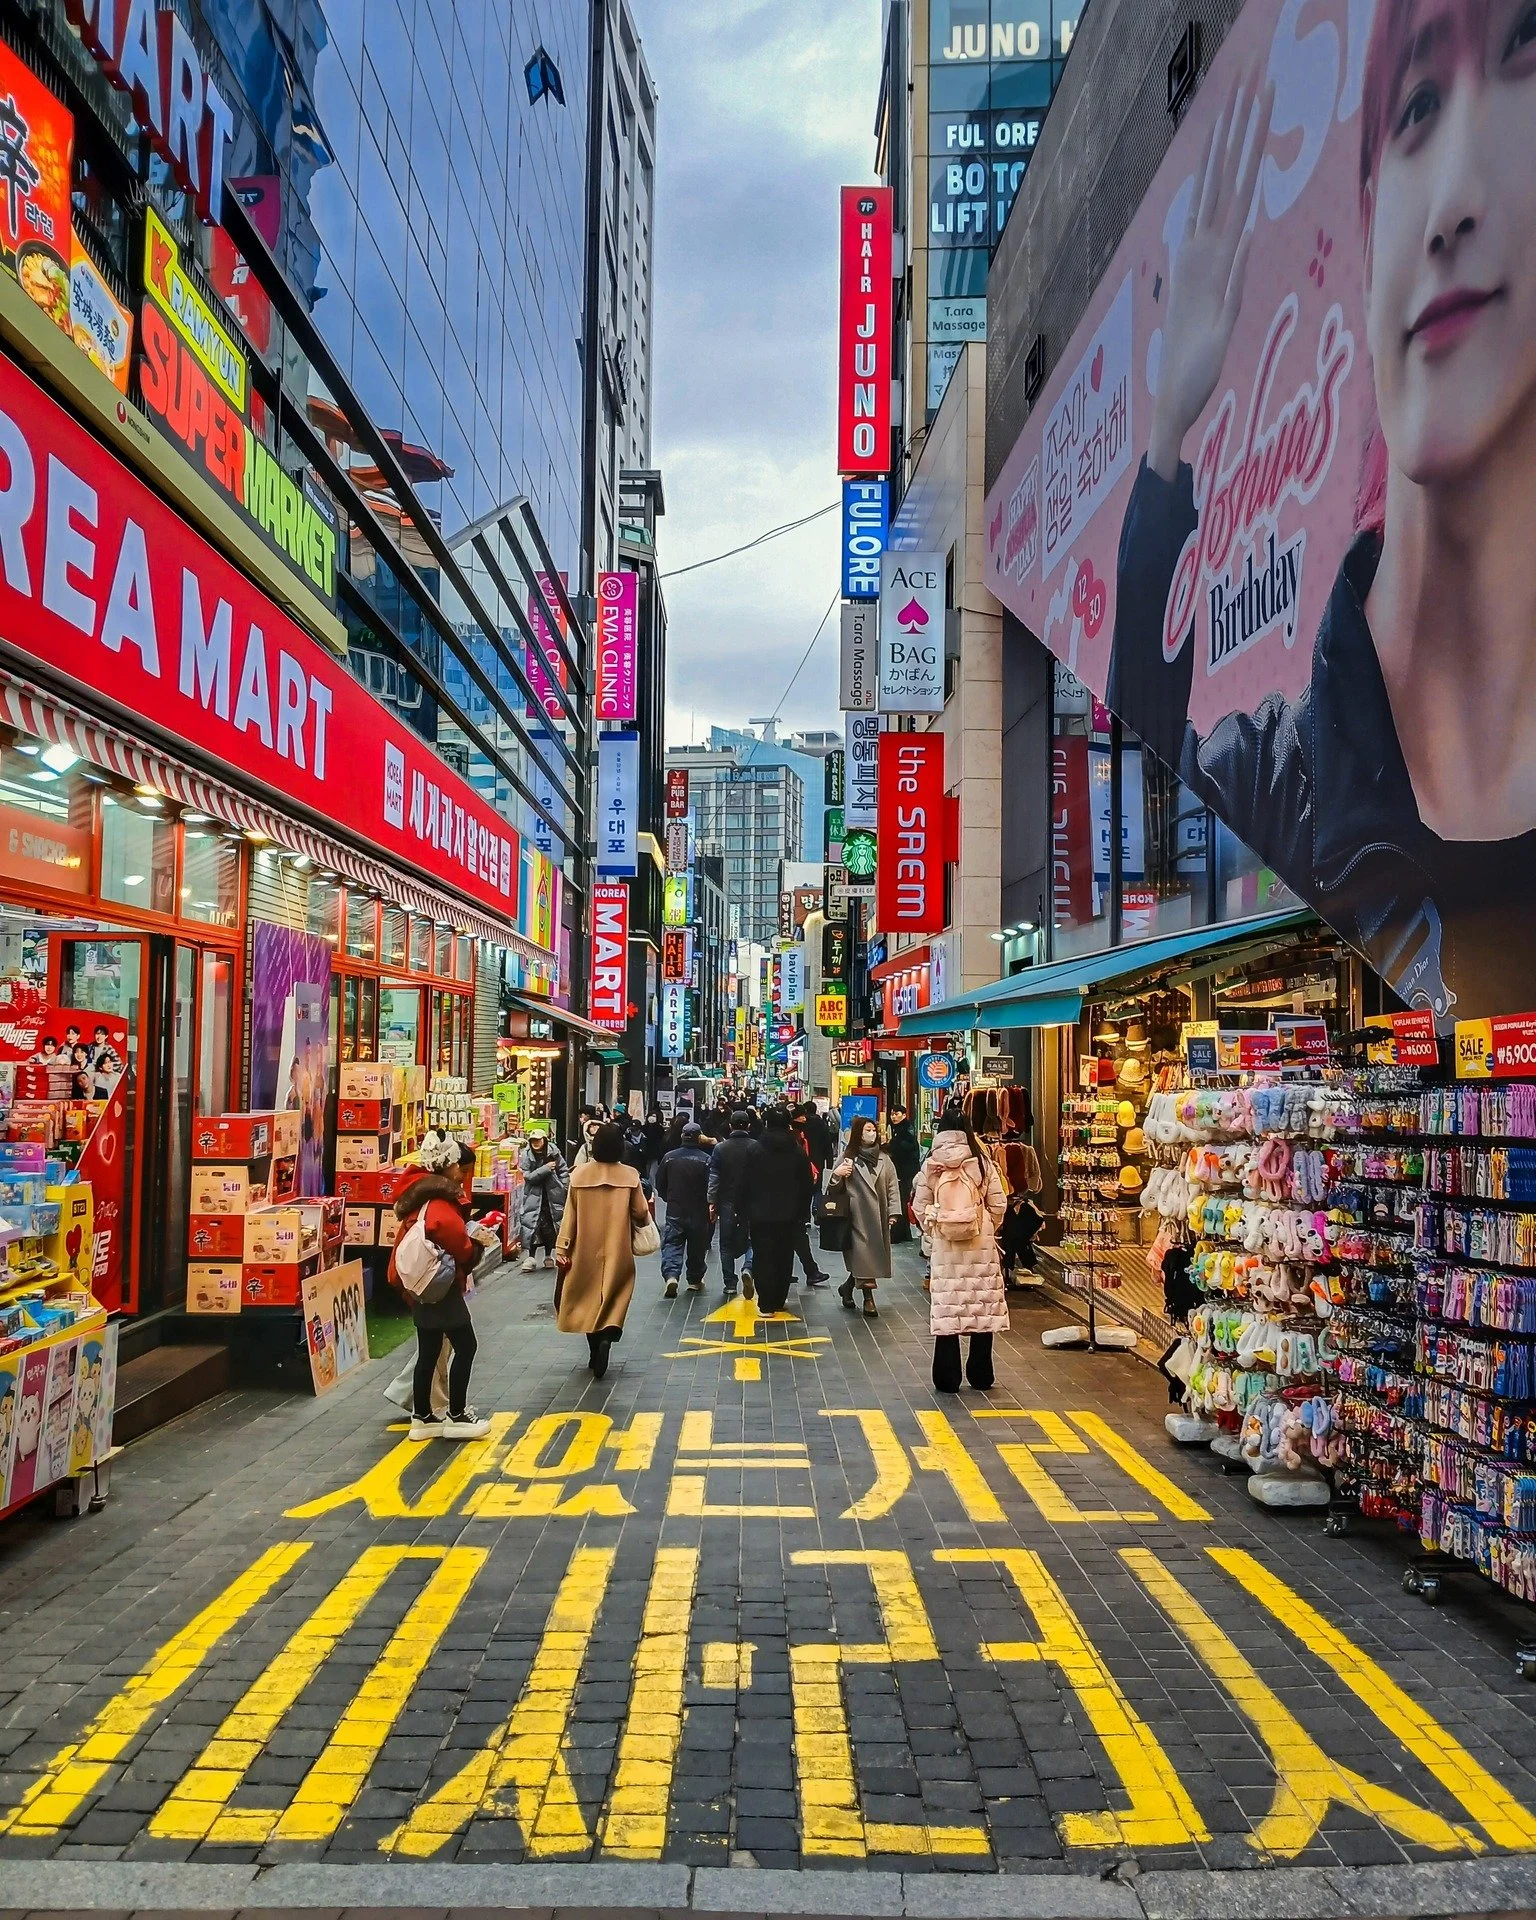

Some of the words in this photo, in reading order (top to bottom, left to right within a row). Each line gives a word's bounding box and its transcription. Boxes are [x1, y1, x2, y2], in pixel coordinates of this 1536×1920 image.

[943, 21, 1040, 60] JUNO
[82, 0, 234, 227] ART
[26, 201, 54, 240] 라면
[860, 202, 873, 212] 7F
[931, 201, 988, 233] LIFT
[860, 222, 873, 293] HAIR
[171, 269, 241, 396] RAMYUN
[932, 321, 986, 332] Massage
[853, 303, 877, 458] JUNO
[1046, 371, 1087, 492] 조슈아
[1045, 472, 1073, 554] 생일
[1076, 374, 1127, 500] 축하해
[848, 483, 882, 593] FULORE
[889, 567, 937, 589] ACE
[1076, 572, 1088, 605] 12
[1088, 598, 1101, 628] 30
[1209, 531, 1303, 667] Birthday
[602, 605, 619, 646] EVIA
[889, 641, 937, 665] BAG
[178, 566, 334, 781] MART
[601, 650, 619, 712] CLINIC
[850, 648, 866, 707] Massage
[881, 685, 942, 696] セレクトショップ
[888, 667, 936, 681] かばん
[897, 746, 926, 793] the
[670, 789, 685, 797] PUB
[670, 800, 685, 809] BAR
[607, 798, 626, 853] 우대포
[594, 888, 626, 899] KOREA
[594, 903, 623, 1014] MART
[667, 935, 676, 976] HAIR
[668, 987, 679, 1054] ARTBOX
[818, 1012, 844, 1021] MART
[819, 1000, 843, 1012] ABC
[1192, 1050, 1211, 1058] SALE
[1459, 1037, 1484, 1057] SALE
